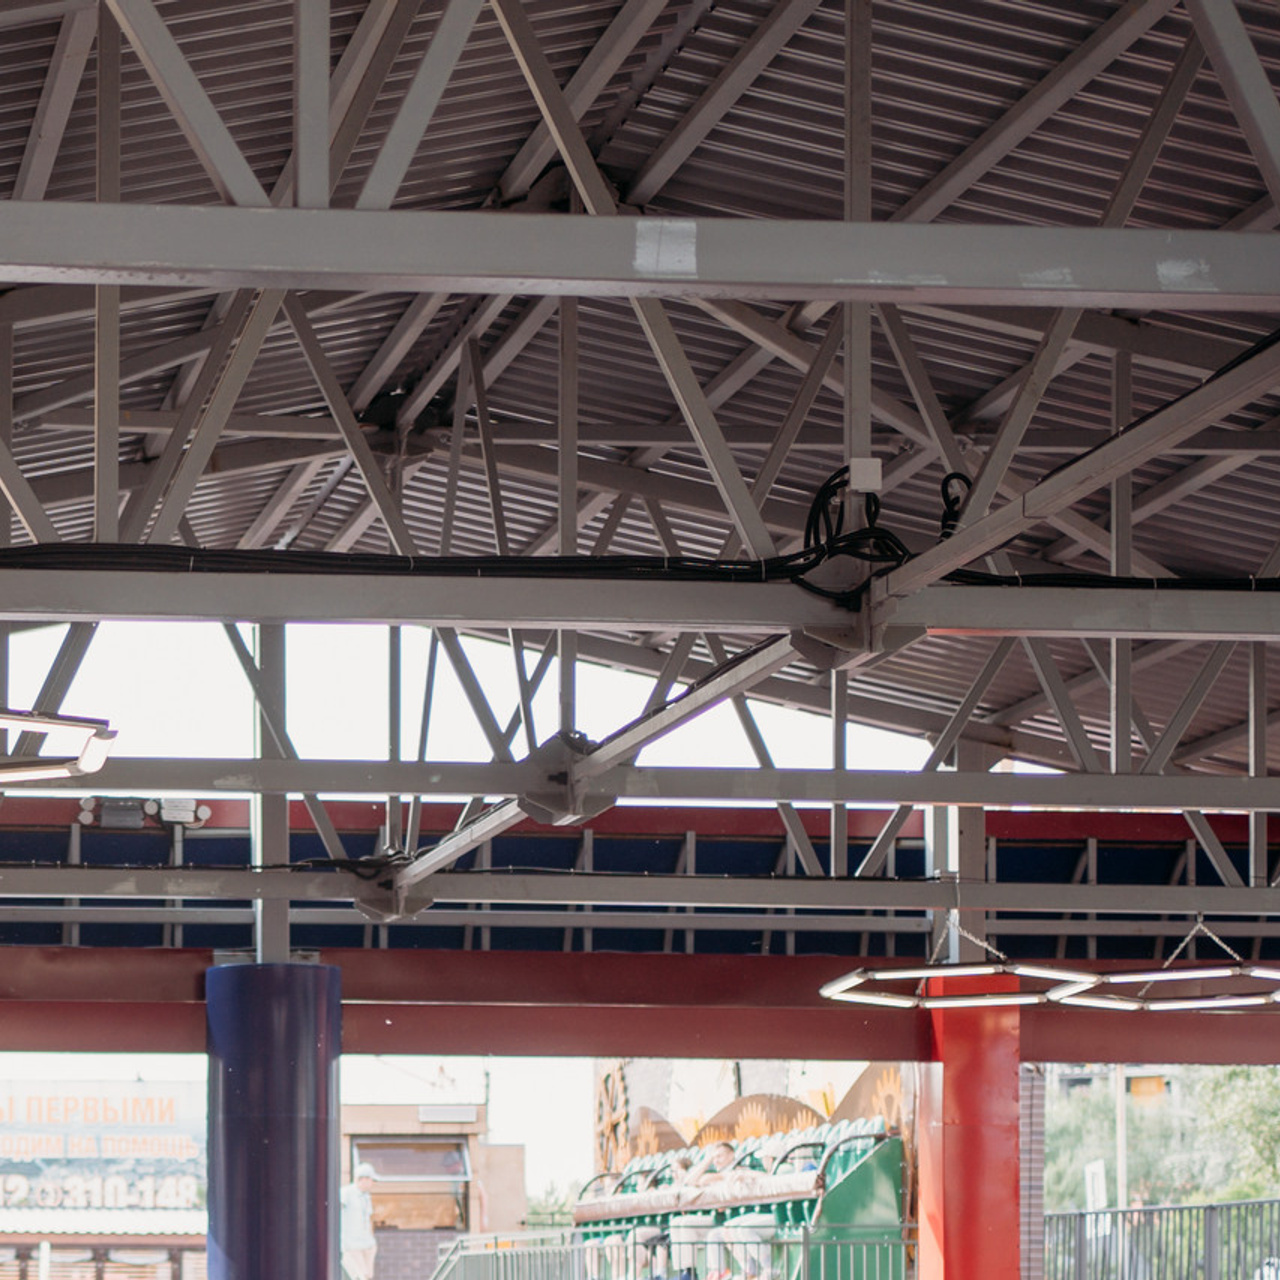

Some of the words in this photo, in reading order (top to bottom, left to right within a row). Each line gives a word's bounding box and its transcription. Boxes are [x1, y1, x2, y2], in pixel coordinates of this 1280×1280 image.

[26, 1096, 176, 1125] ПЕРВЫМИ
[68, 1136, 97, 1158] НА
[101, 1136, 199, 1161] ПОМОЩЬ
